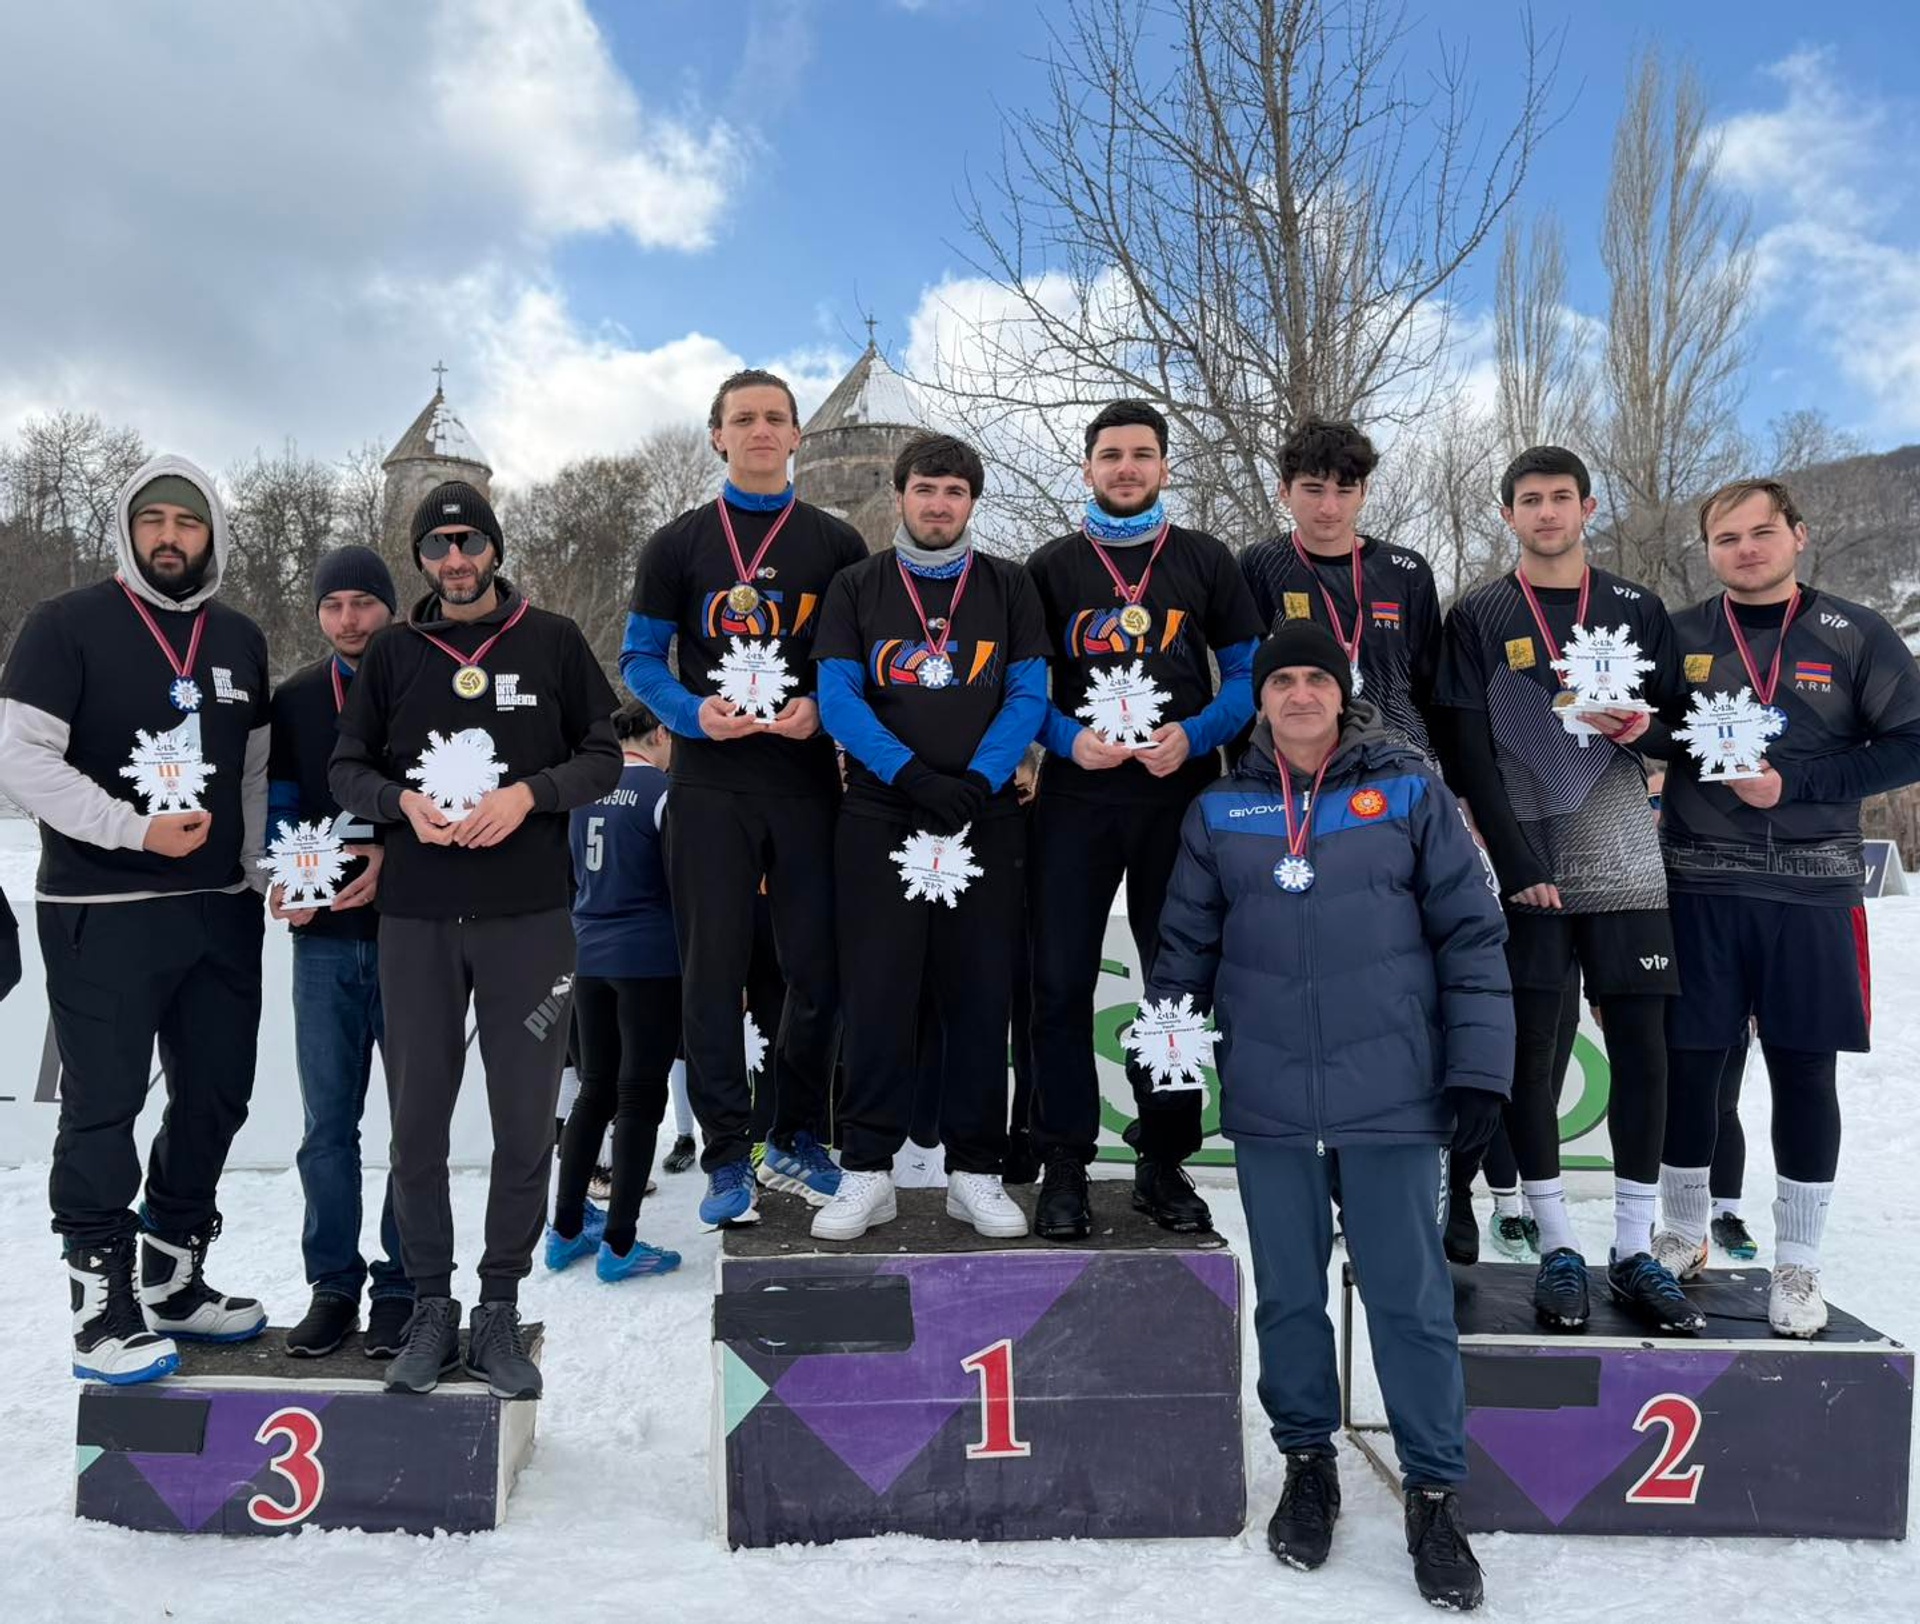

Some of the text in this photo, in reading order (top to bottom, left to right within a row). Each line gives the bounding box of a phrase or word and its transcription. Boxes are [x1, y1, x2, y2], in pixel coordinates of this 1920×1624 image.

[1795, 680, 1831, 693] ARM
[585, 816, 605, 872] 5
[960, 1338, 1031, 1459] 1
[1625, 1393, 1705, 1504] 2
[247, 1406, 325, 1526] 3
